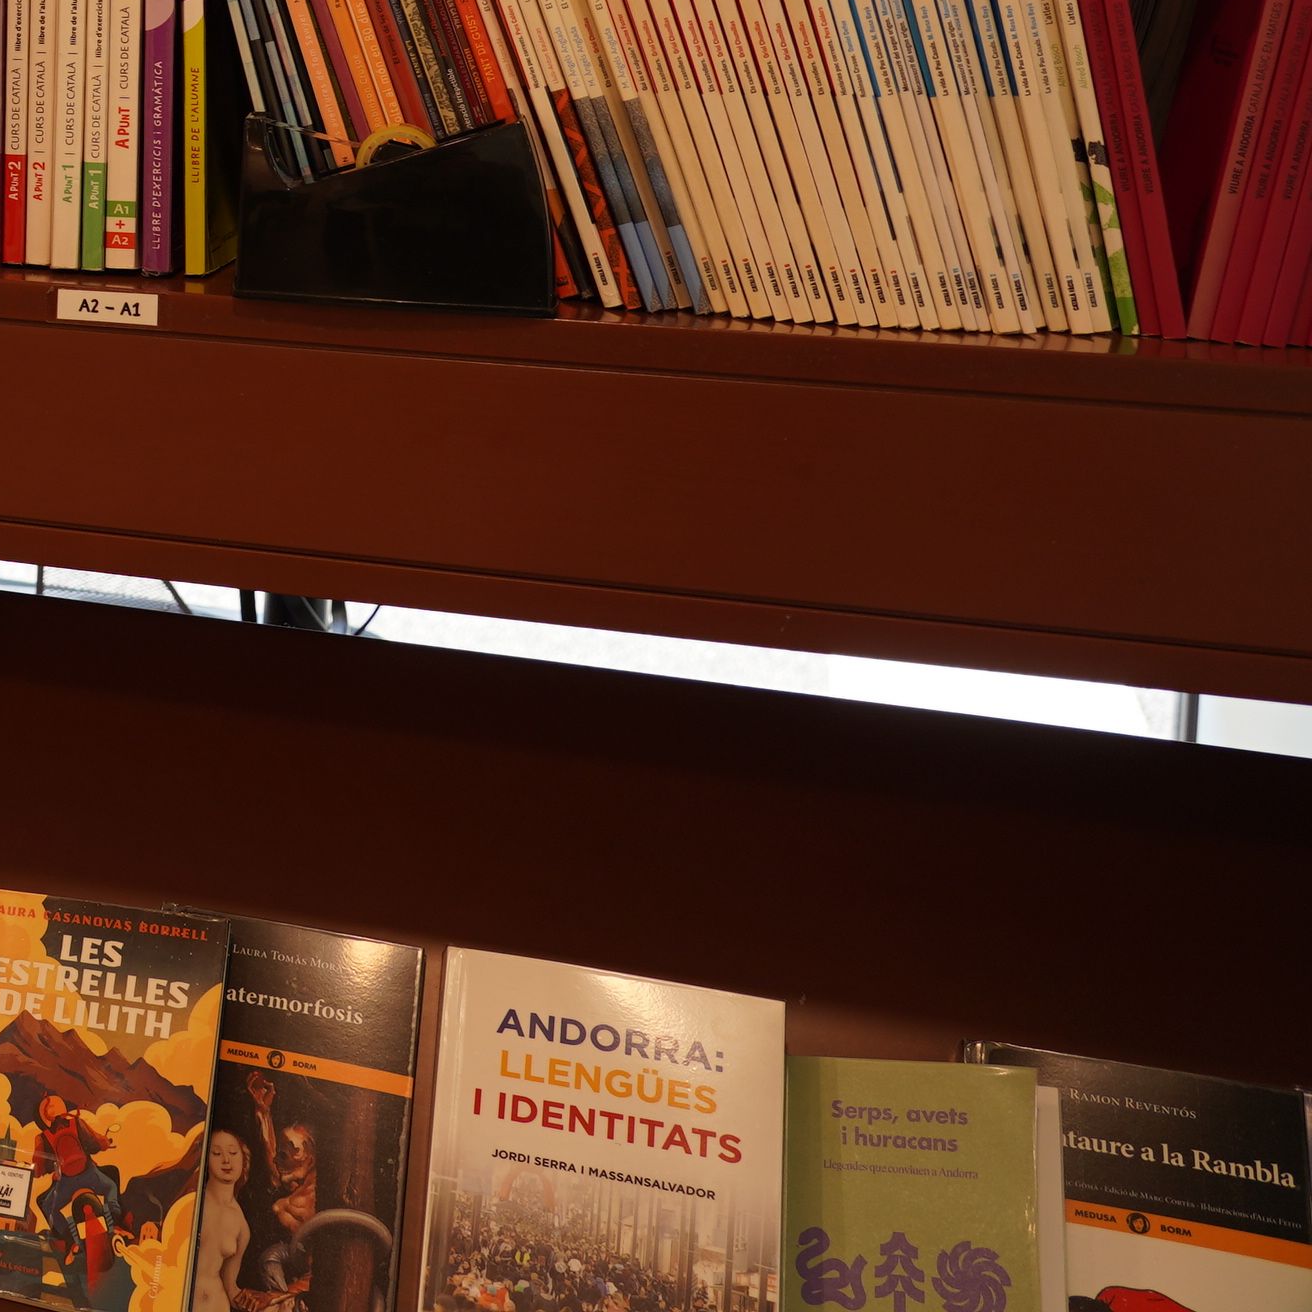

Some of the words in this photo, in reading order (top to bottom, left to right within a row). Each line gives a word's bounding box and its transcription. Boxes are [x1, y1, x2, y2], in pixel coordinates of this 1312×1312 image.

[79, 299, 99, 313] A2
[120, 301, 141, 316] A1
[43, 909, 133, 933] CASANOVAS
[139, 921, 209, 942] BORRELL
[60, 935, 125, 968] LES
[53, 996, 173, 1040] LILITH
[226, 986, 364, 1026] atermorfosis
[226, 1047, 260, 1061] MEDUSA
[496, 1009, 725, 1073] ANDORRA:
[500, 1050, 718, 1114] LLENGÜES
[497, 1092, 743, 1164] IDENTITATS
[832, 1100, 898, 1123] Serps,
[907, 1108, 969, 1125] avets
[854, 1128, 958, 1152] huracans
[491, 1149, 530, 1164] JORDI
[534, 1154, 577, 1173] SERRA
[588, 1166, 716, 1200] MASSANSALVADOR
[1140, 1146, 1155, 1162] a
[1161, 1144, 1184, 1166] la
[1192, 1150, 1296, 1188] Rambla
[1074, 1209, 1116, 1224] MEDUSA
[1160, 1224, 1192, 1237] BORM
